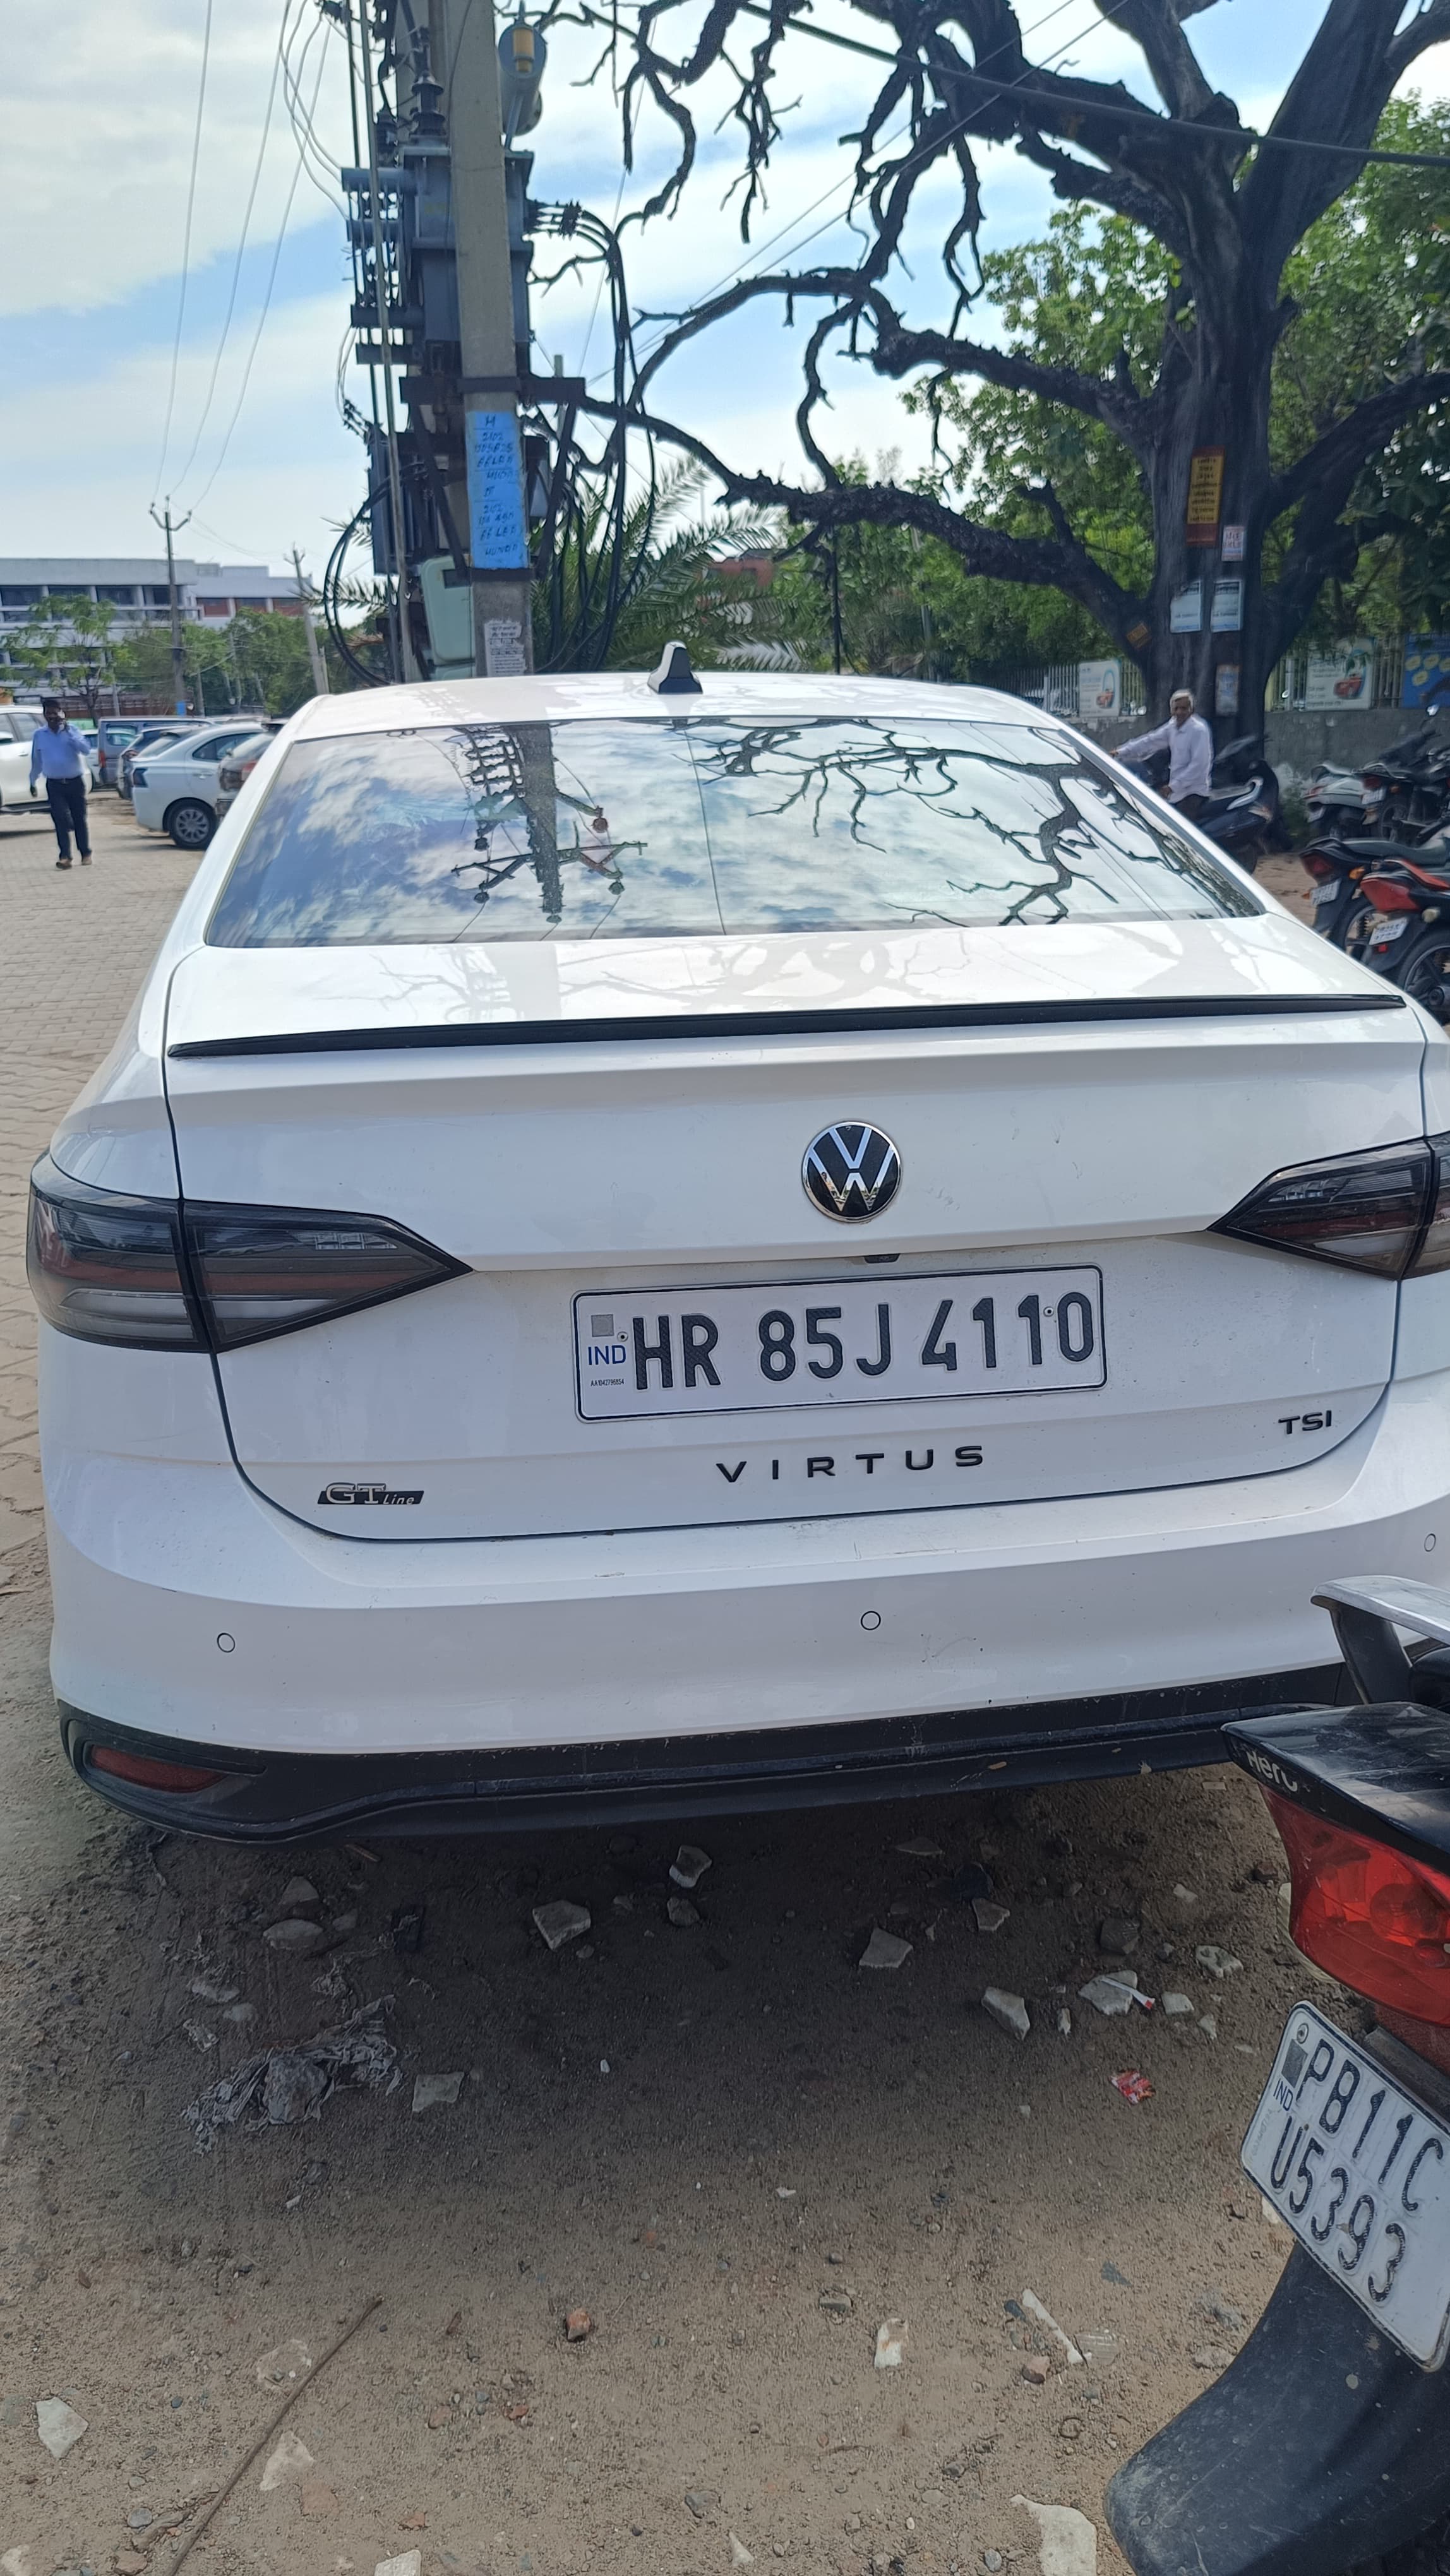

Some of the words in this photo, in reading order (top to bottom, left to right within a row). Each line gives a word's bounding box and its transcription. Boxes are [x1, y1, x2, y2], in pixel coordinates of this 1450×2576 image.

[588, 1345, 626, 1366] IND
[632, 1313, 721, 1390] HR
[758, 1303, 891, 1381] 85J
[921, 1291, 1094, 1372] 4110
[1278, 1410, 1332, 1434] TSI
[716, 1445, 983, 1482] VIRTUS
[326, 1482, 386, 1505] GT
[383, 1494, 415, 1505] Line
[1273, 2078, 1293, 2111] IND
[1271, 2115, 1406, 2303] U5393
